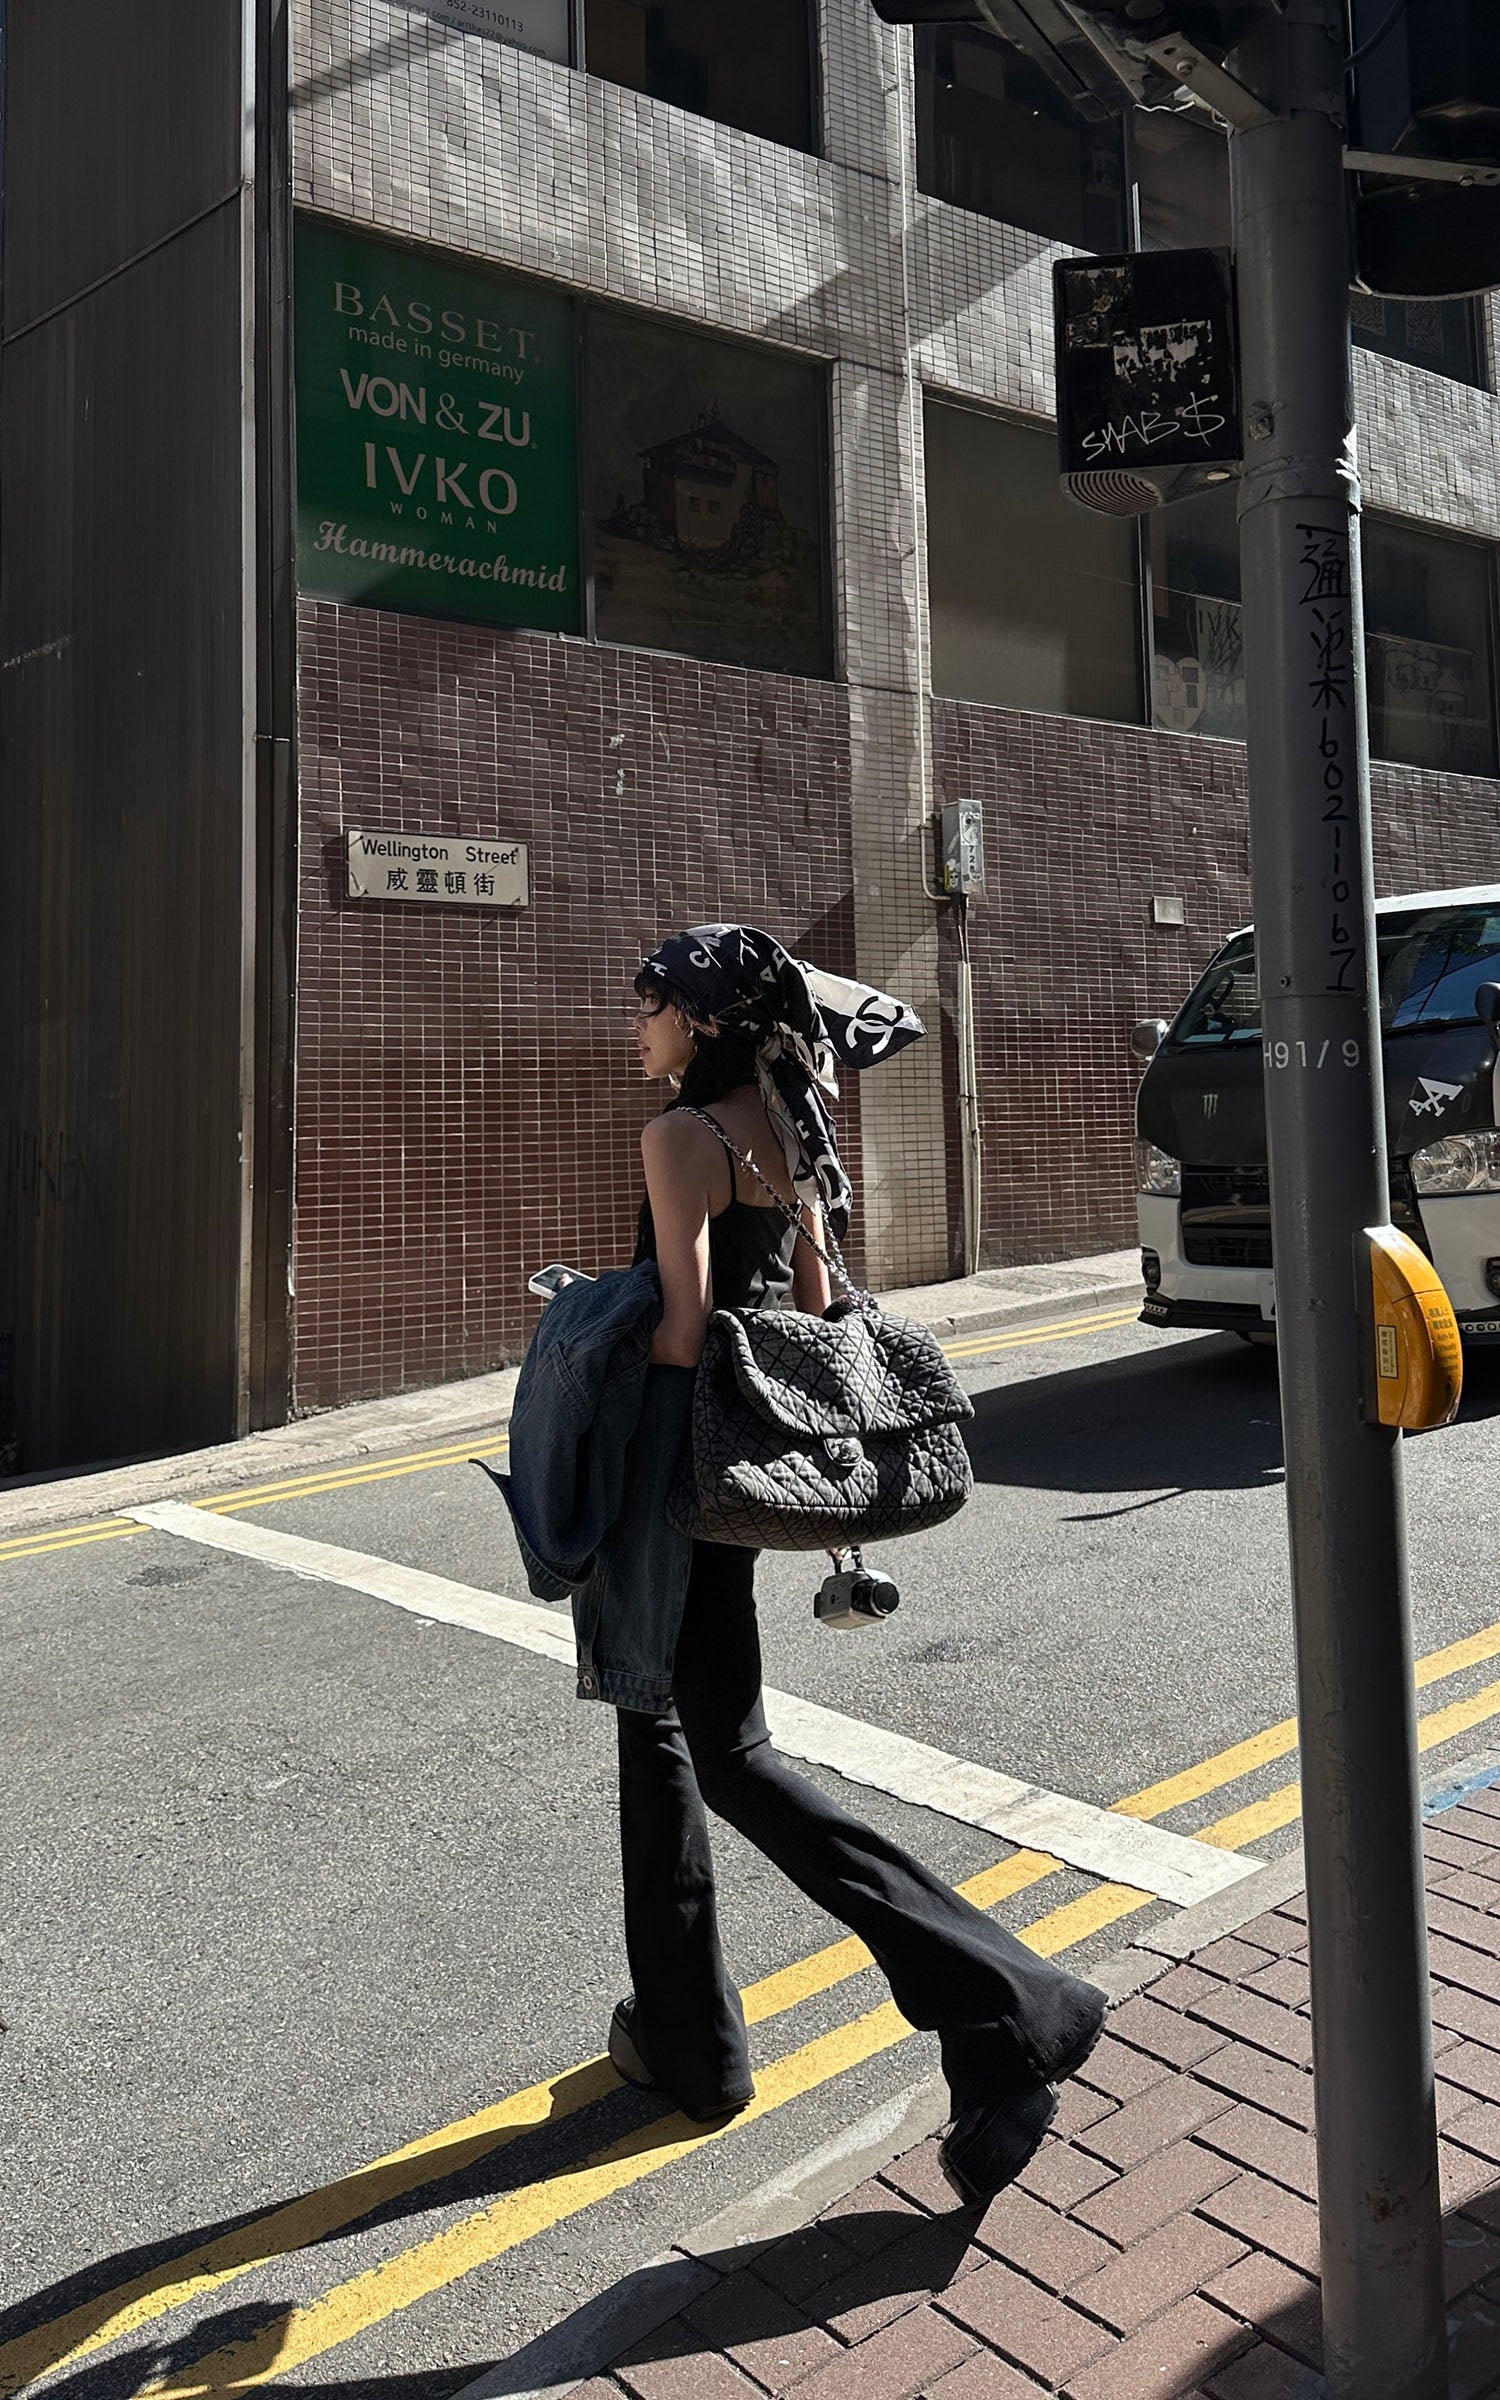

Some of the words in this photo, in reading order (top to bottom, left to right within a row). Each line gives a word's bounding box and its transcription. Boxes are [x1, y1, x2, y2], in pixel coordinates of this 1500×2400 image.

[332, 281, 536, 360] BASSET
[348, 325, 407, 354] made
[414, 338, 432, 359] in
[438, 348, 525, 386] germany
[339, 368, 427, 425] VON
[435, 392, 471, 435] &
[477, 400, 531, 447] ZU
[364, 441, 519, 516] IVKO
[390, 500, 497, 534] WOMAN
[362, 838, 449, 862] Wellington
[465, 845, 518, 866] Street
[386, 867, 495, 897] 威靈頓街
